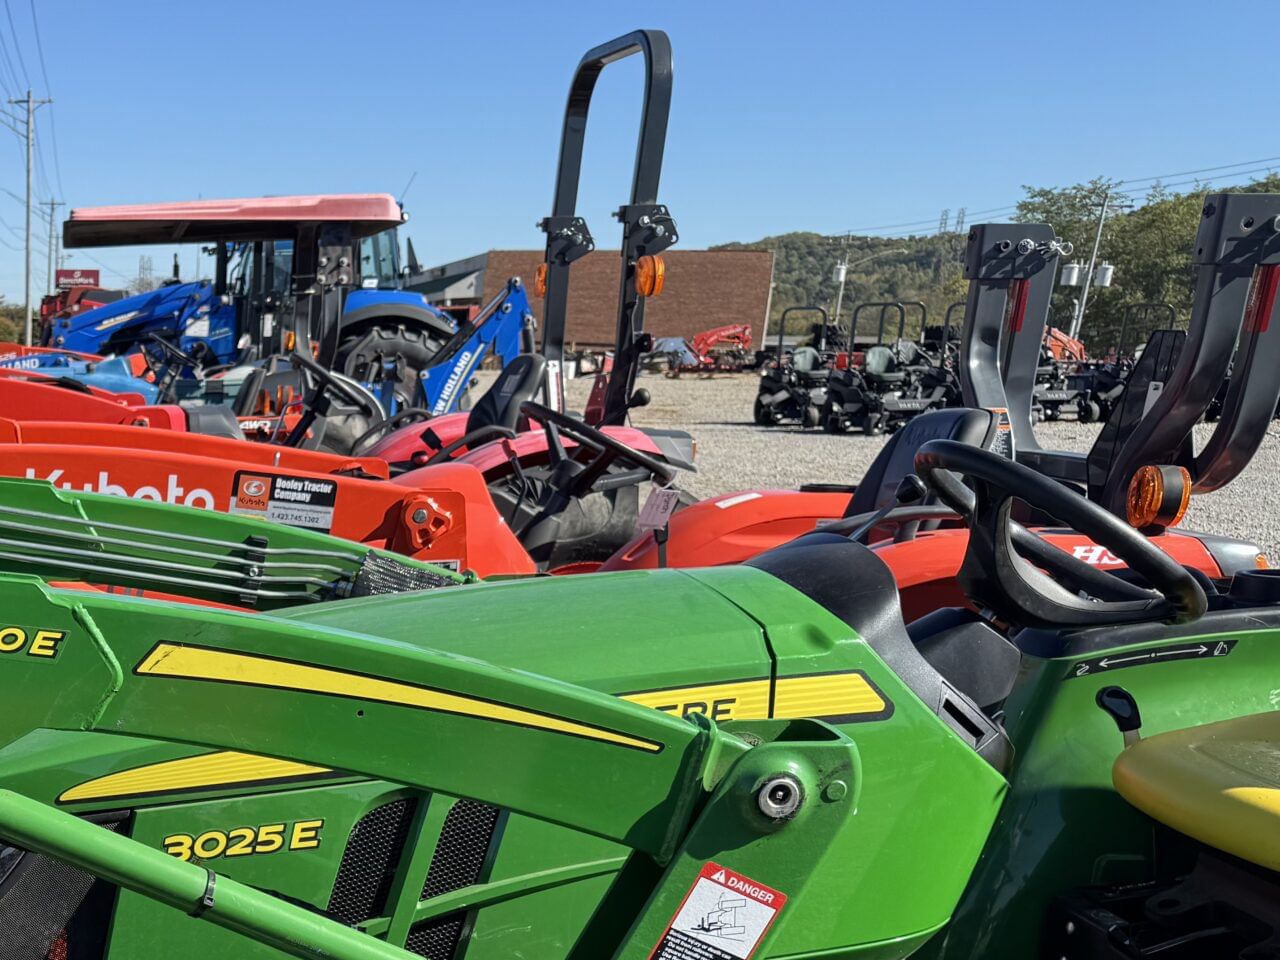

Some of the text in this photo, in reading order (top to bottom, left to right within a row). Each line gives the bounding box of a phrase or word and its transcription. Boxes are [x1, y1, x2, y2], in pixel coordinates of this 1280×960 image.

[440, 351, 472, 401] HOLLAND
[274, 488, 312, 502] Company
[275, 478, 333, 494] Dooley Tractor
[727, 876, 775, 904] DANGER
